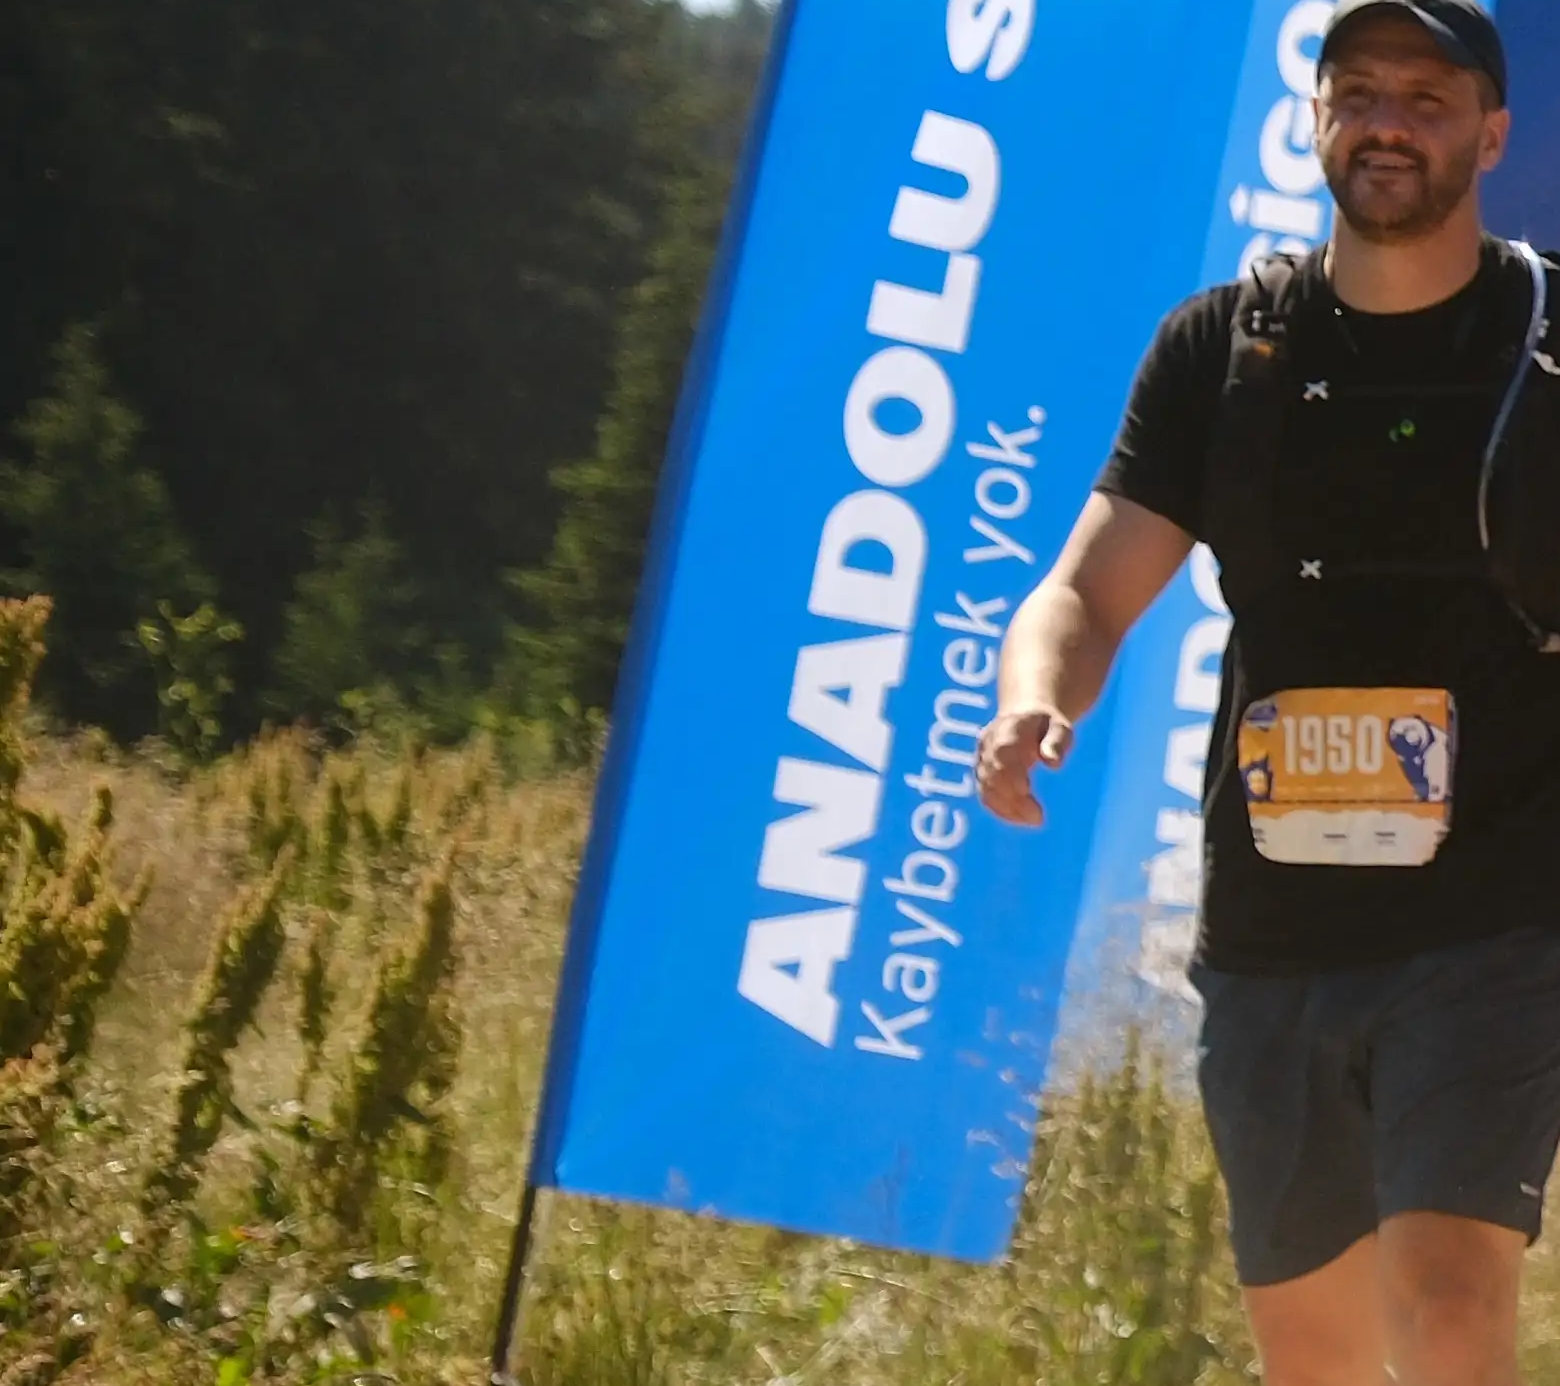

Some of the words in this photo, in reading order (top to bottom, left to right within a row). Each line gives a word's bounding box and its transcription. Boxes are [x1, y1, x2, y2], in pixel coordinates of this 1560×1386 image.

[738, 109, 999, 1047] ANADOLU
[854, 590, 1008, 1059] Kaybetmek
[963, 404, 1047, 563] yok.
[1281, 714, 1384, 775] 1950
